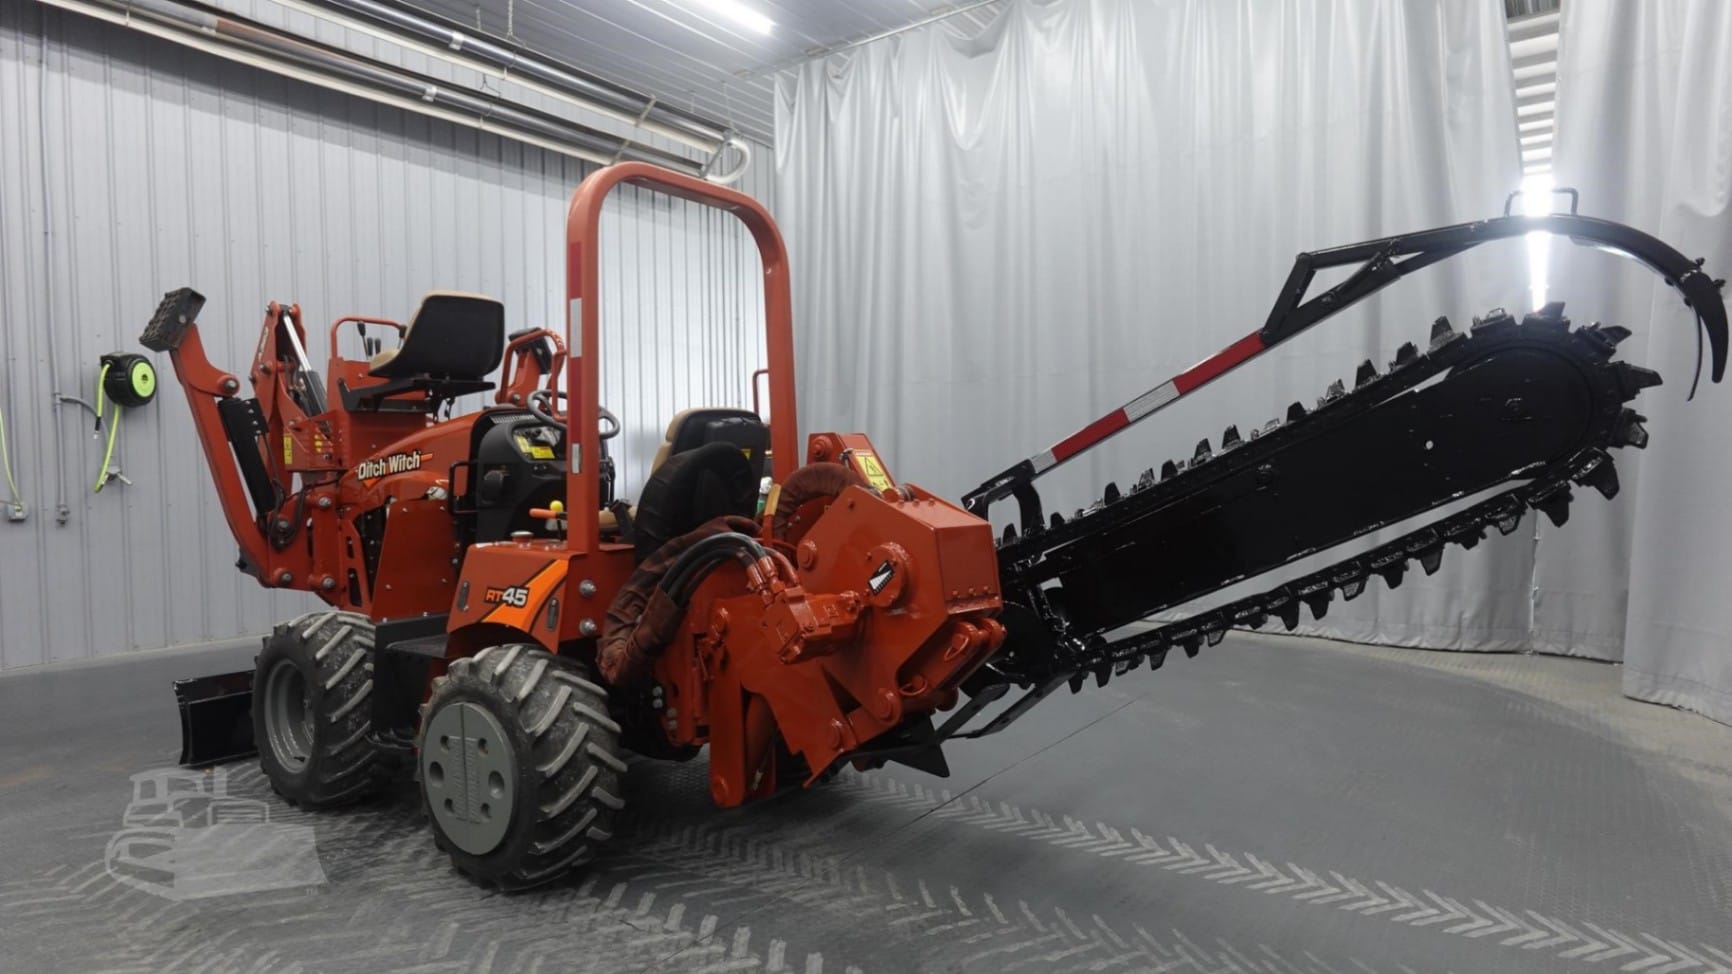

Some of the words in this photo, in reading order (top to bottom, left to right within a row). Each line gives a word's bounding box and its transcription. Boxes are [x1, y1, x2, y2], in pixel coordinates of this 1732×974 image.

[358, 458, 386, 480] Ditch
[388, 450, 421, 473] Witch
[486, 587, 528, 606] RT45
